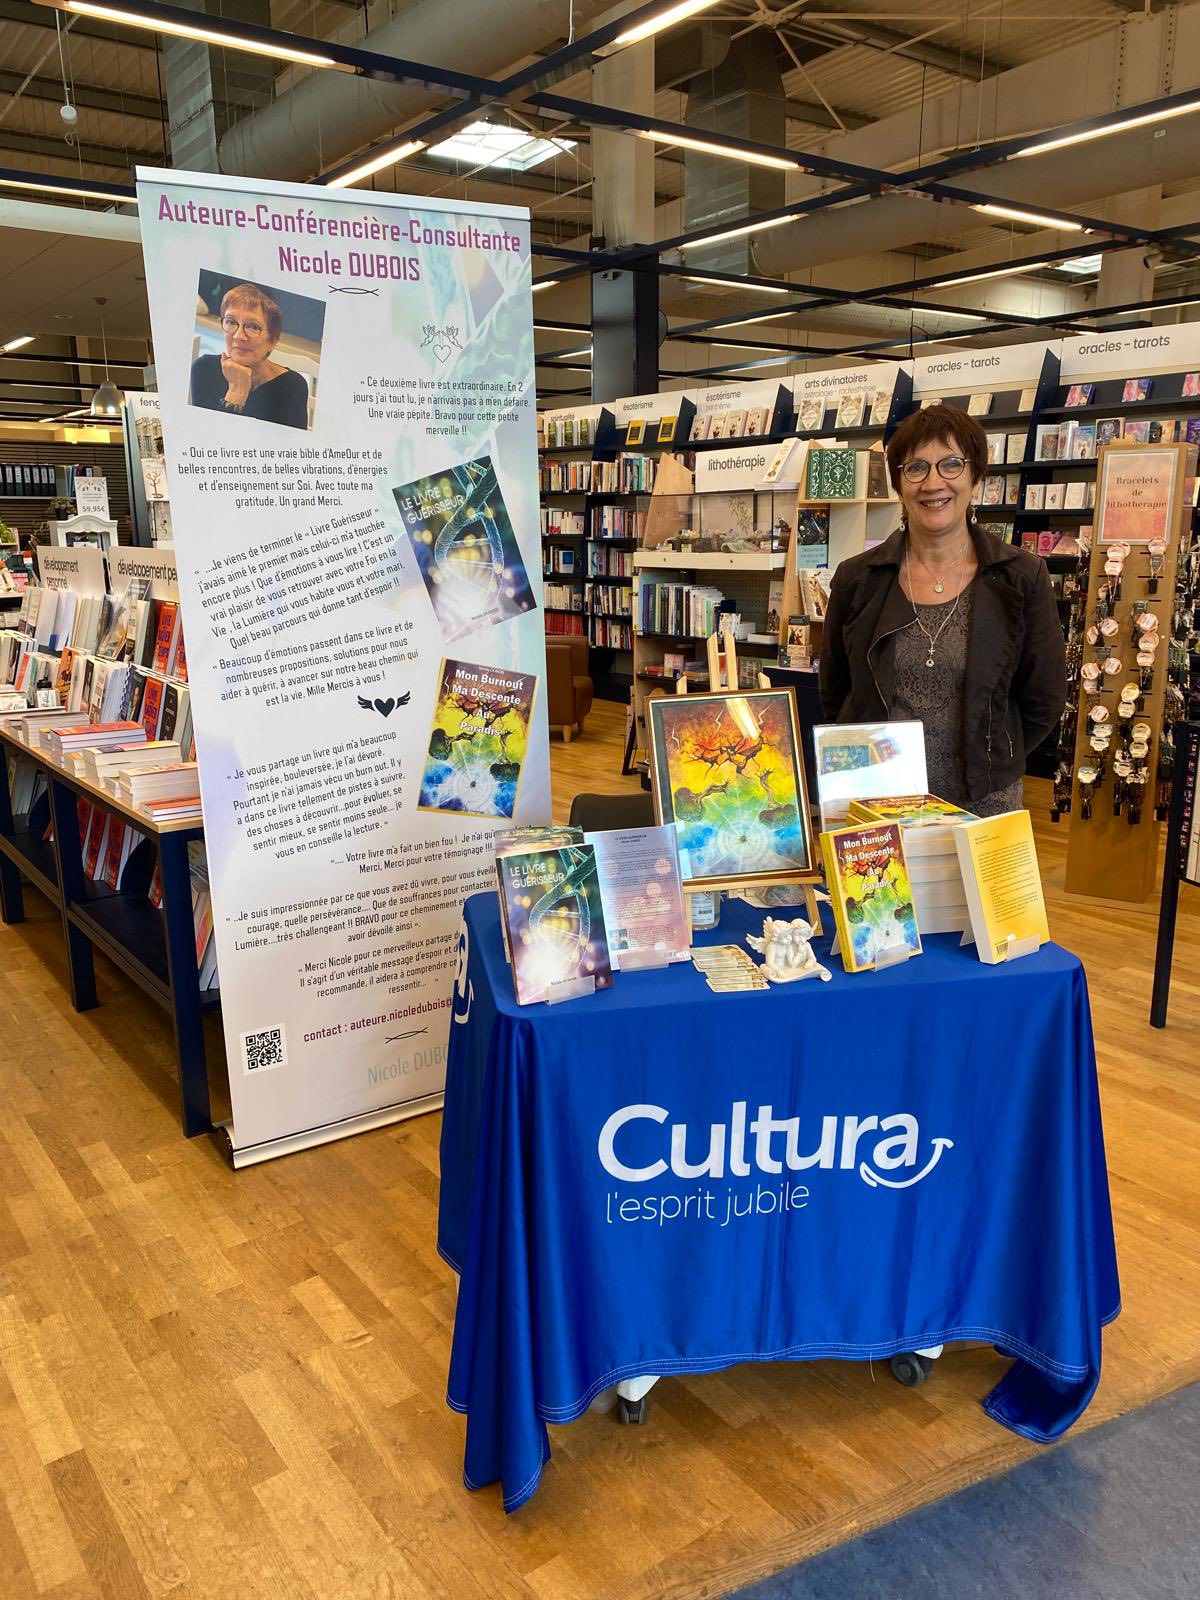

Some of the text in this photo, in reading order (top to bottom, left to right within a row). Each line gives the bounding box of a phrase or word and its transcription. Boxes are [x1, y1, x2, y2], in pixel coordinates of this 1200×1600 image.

[158, 194, 521, 253] Auteure-Conférencière-Consultante
[278, 246, 421, 282] Nicole DUBOIS
[1078, 340, 1122, 356] oracles
[1132, 335, 1170, 351] tarots
[927, 360, 962, 375] oracles
[970, 355, 1000, 371] tarots
[366, 375, 523, 392] Ce deuxième livre est extraordinaire. En 2
[805, 372, 868, 389] arts divinatoires
[705, 389, 742, 402] ésotérisme
[368, 407, 519, 423] Une vraie pépite. Bravo pour cette petite
[622, 401, 654, 411] ésotérisme
[425, 424, 459, 435] merveille
[189, 446, 204, 458] Oui
[206, 449, 218, 458] ce
[220, 447, 239, 458] livre
[242, 448, 257, 458] est
[259, 450, 274, 458] une
[277, 448, 297, 458] vraie
[299, 447, 319, 458] bible
[361, 449, 370, 459] et
[372, 448, 382, 459] de
[707, 453, 766, 472] lithothérapie
[177, 462, 387, 476] belles rencontres, de belles vibrations, d'énergies
[198, 479, 373, 492] et d'enseignement sur Soi. Avec toute ma
[1116, 476, 1159, 485] Bracelets
[235, 495, 343, 508] gratitude. Un grand Merci.
[400, 486, 441, 510] LE LIVRE
[407, 494, 465, 524] GUÉRISSEUR
[223, 552, 247, 566] viens
[248, 546, 259, 557] de
[259, 535, 293, 553] terminer
[293, 531, 303, 541] le
[309, 523, 330, 536] Livre
[330, 508, 372, 528] Guérisseur
[197, 520, 385, 594] j'avais aimé le premier mais celui-ci m'a touchée
[118, 558, 166, 579] développement
[225, 637, 408, 684] nombreuses propositions, solutions pour nous
[455, 669, 478, 682] Mon
[481, 674, 524, 690] Burnout
[452, 685, 521, 705] Ma Descente
[476, 709, 490, 719] Au
[460, 721, 500, 736] Paradis
[245, 746, 384, 791] inspirée, bouleversée, je l'ai dévoré.
[843, 832, 892, 849] Mon Burnout
[359, 842, 494, 874] Merci, Merci pour votre témoignage !!!
[845, 846, 895, 862] Ma Descente
[510, 862, 546, 877] LE LIVRE
[512, 872, 565, 889] GUÉRISSEUR
[246, 921, 282, 934] courage,
[284, 914, 308, 928] quelle
[372, 899, 386, 911] Que
[388, 896, 397, 906] de
[399, 890, 441, 904] souffrances
[443, 886, 458, 897] pour
[460, 880, 494, 896] contacter
[295, 921, 346, 938] challengeant
[354, 913, 379, 927] BRAVO
[381, 912, 398, 923] pour
[410, 898, 456, 915] cheminement
[316, 958, 456, 998] recommande, il aidera à comprendre ce
[303, 1024, 342, 1042] contact
[368, 1060, 410, 1086] Nicole
[598, 1101, 919, 1182] Cultura
[607, 1181, 810, 1226] l'esprit jubile
